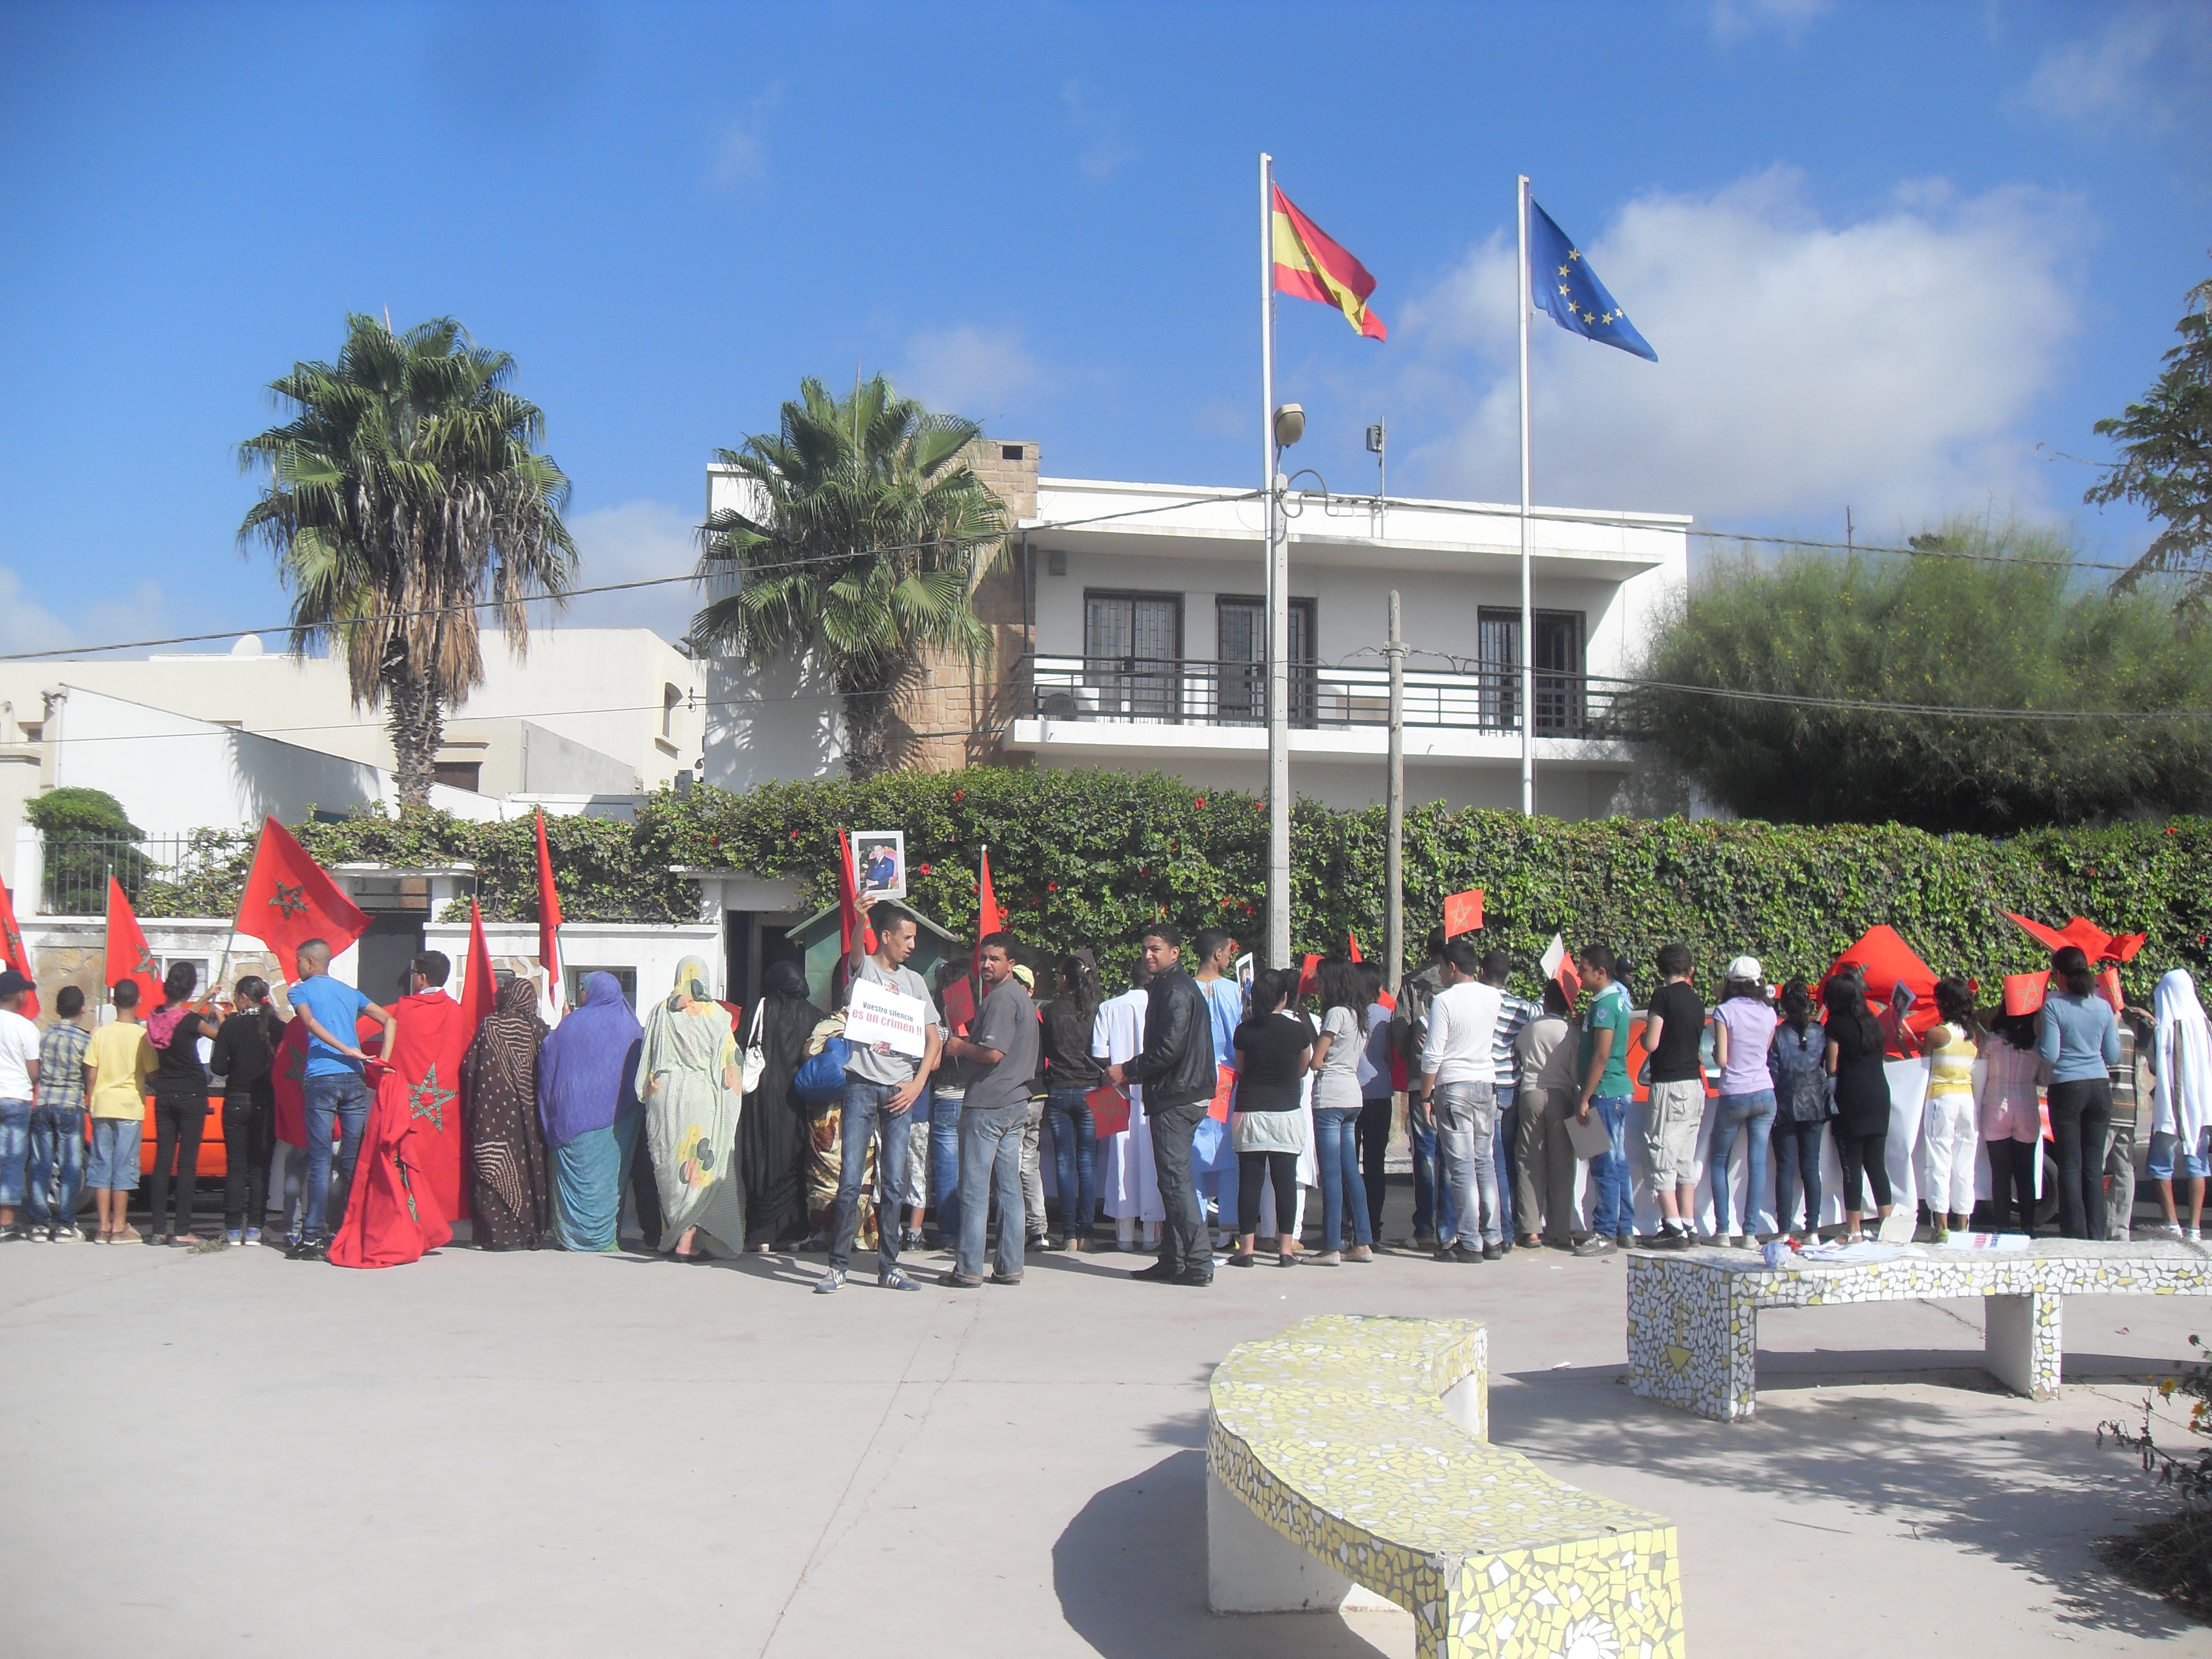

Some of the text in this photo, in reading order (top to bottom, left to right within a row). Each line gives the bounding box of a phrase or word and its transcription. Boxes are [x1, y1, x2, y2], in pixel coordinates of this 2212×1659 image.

[852, 1009, 922, 1036] es un crimen !!
[863, 1000, 913, 1022] Vuestro silencio
